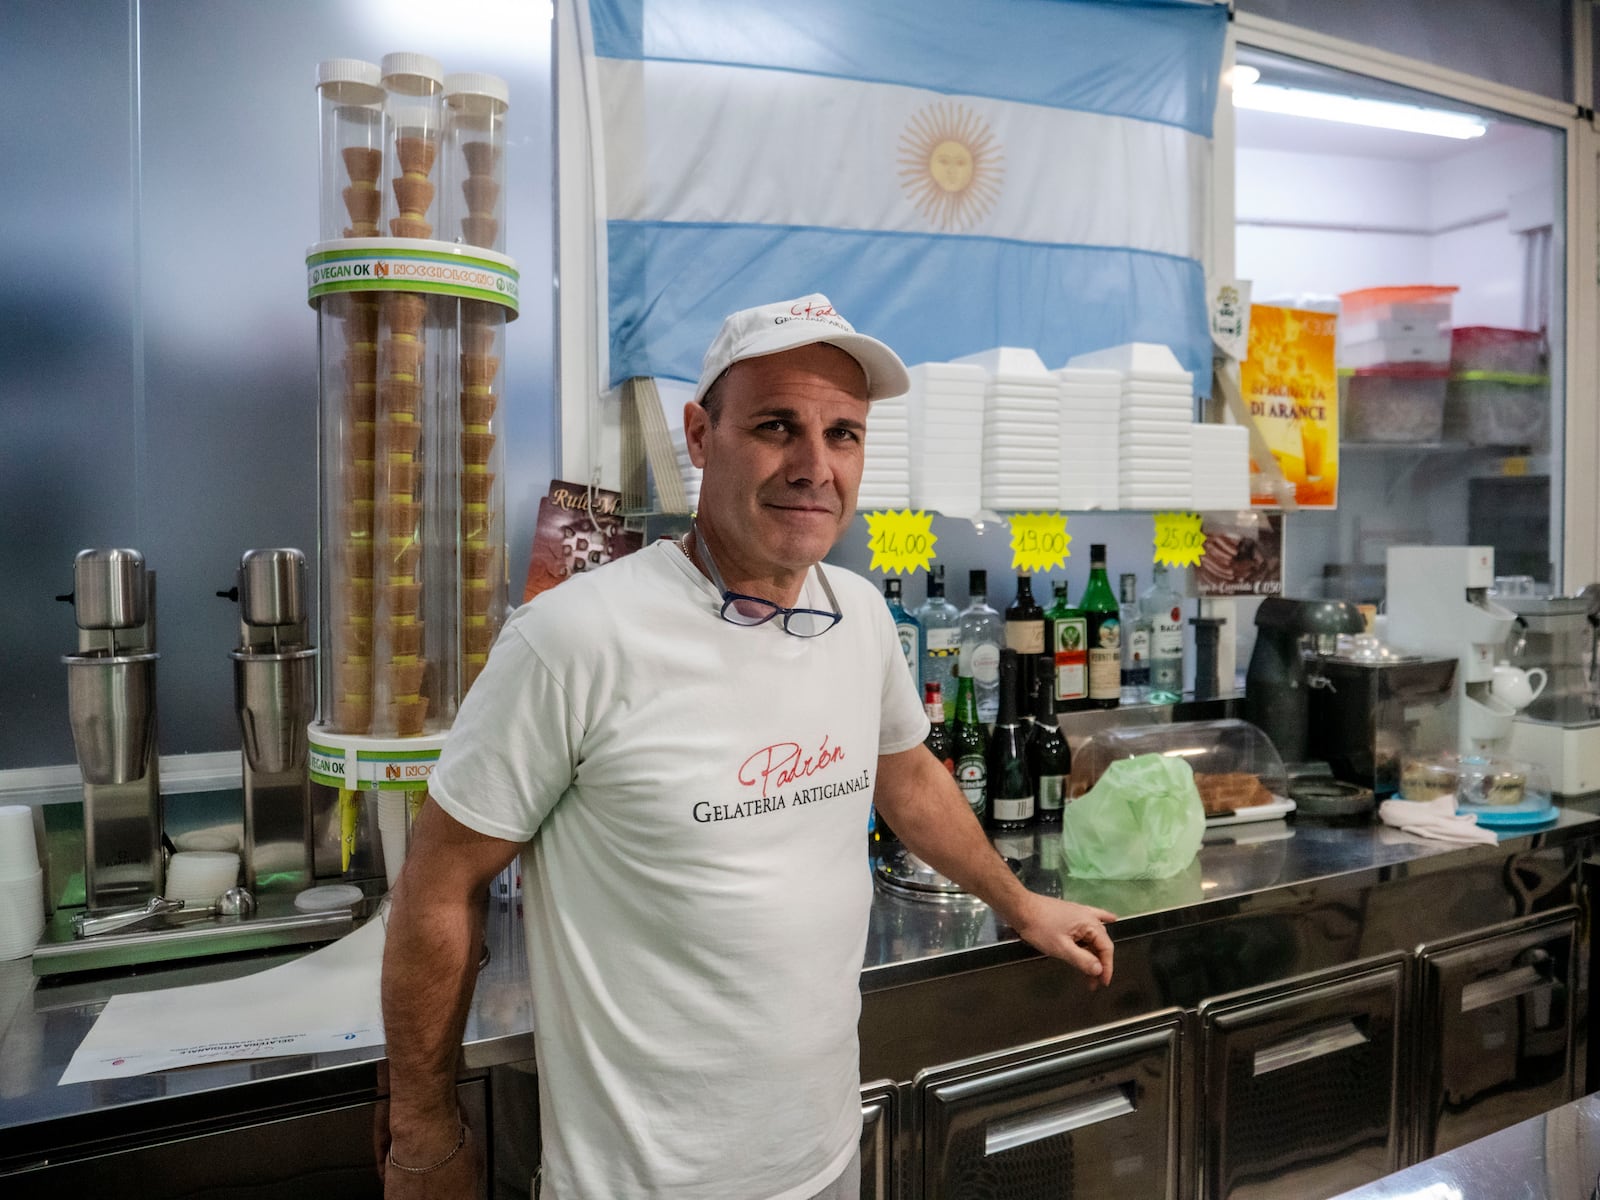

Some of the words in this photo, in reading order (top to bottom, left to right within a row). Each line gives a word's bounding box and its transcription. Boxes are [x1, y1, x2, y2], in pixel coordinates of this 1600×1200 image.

[320, 264, 351, 280] VEGAN
[353, 264, 370, 276] OK
[1251, 401, 1265, 416] DI
[1269, 403, 1326, 420] ARANCE
[875, 529, 927, 557] 14,00
[1017, 529, 1065, 555] 19,00
[332, 762, 345, 775] OK
[738, 735, 846, 798] Padrón
[692, 795, 786, 823] GELATERIA
[792, 769, 870, 806] ARTIGIANALE
